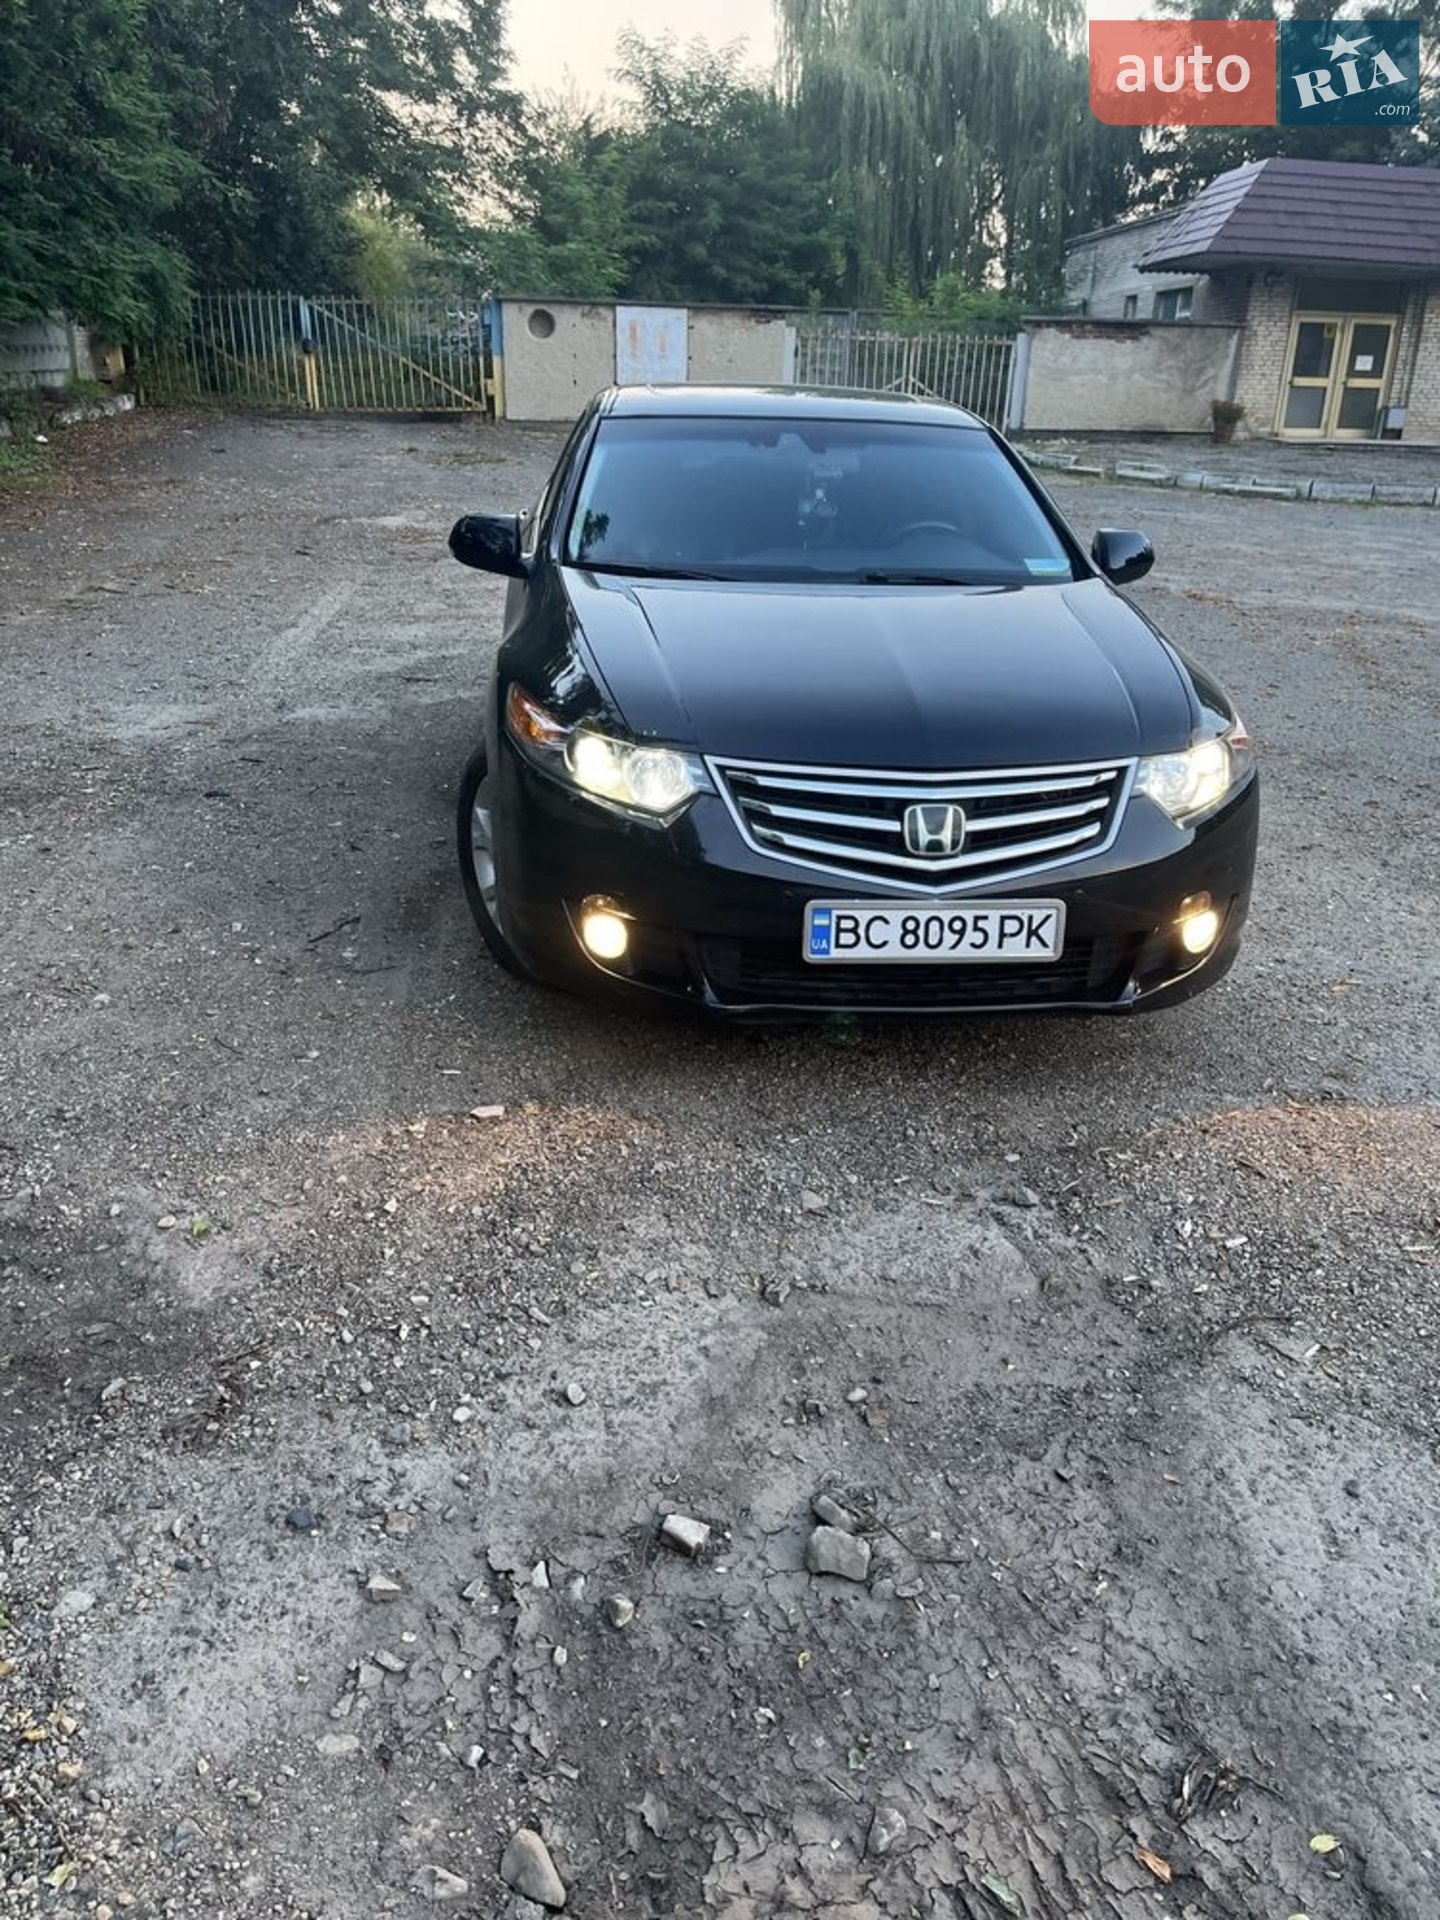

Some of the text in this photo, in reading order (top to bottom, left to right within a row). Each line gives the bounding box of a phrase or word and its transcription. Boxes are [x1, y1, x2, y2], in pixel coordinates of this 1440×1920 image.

[834, 913, 1053, 950] BC 8095 PK
[811, 938, 828, 950] UA
